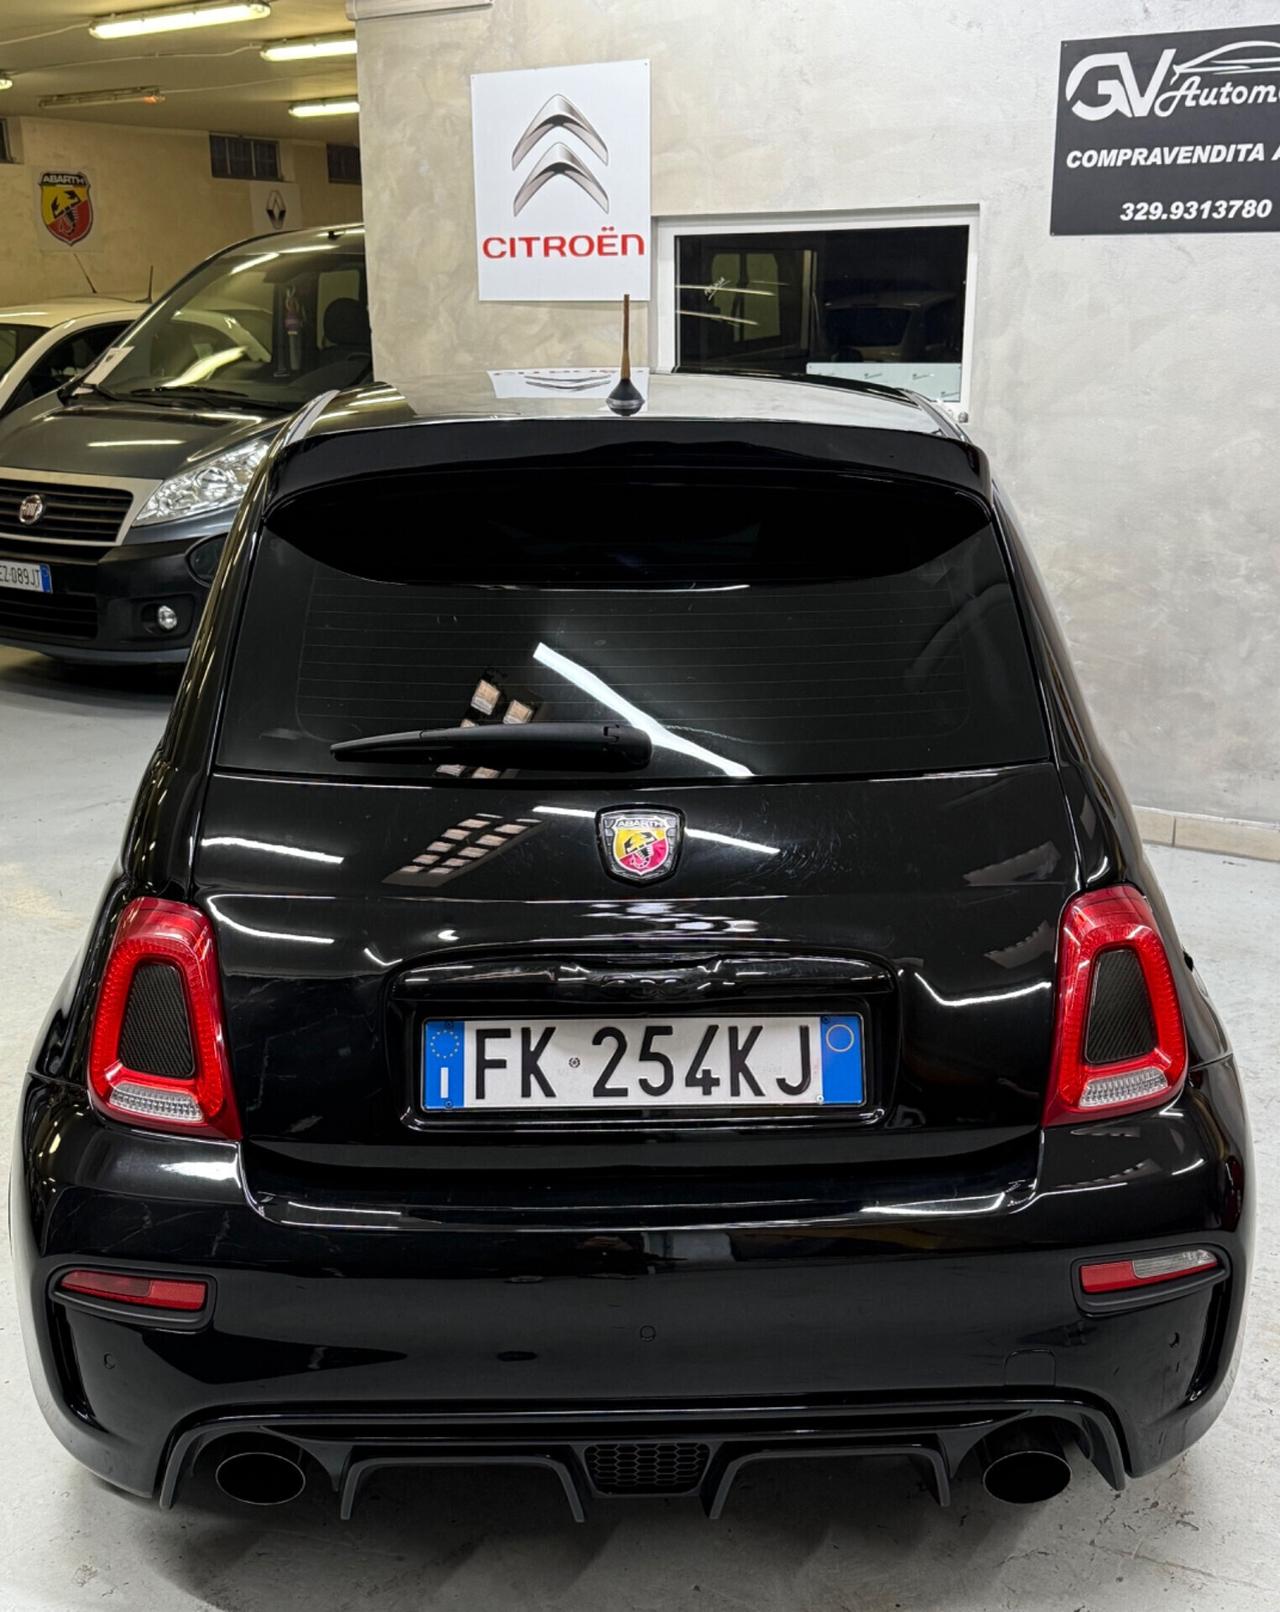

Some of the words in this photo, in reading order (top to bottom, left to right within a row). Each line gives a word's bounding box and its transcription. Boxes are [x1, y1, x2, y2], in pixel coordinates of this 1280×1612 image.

[1065, 48, 1177, 121] GV
[1153, 75, 1280, 117] Autom
[1066, 143, 1265, 168] COMPRAVENDITA
[43, 175, 85, 185] ABARTH
[1119, 199, 1273, 221] 329.9313780
[475, 1026, 557, 1099] FK
[592, 1024, 810, 1098] 254KJ
